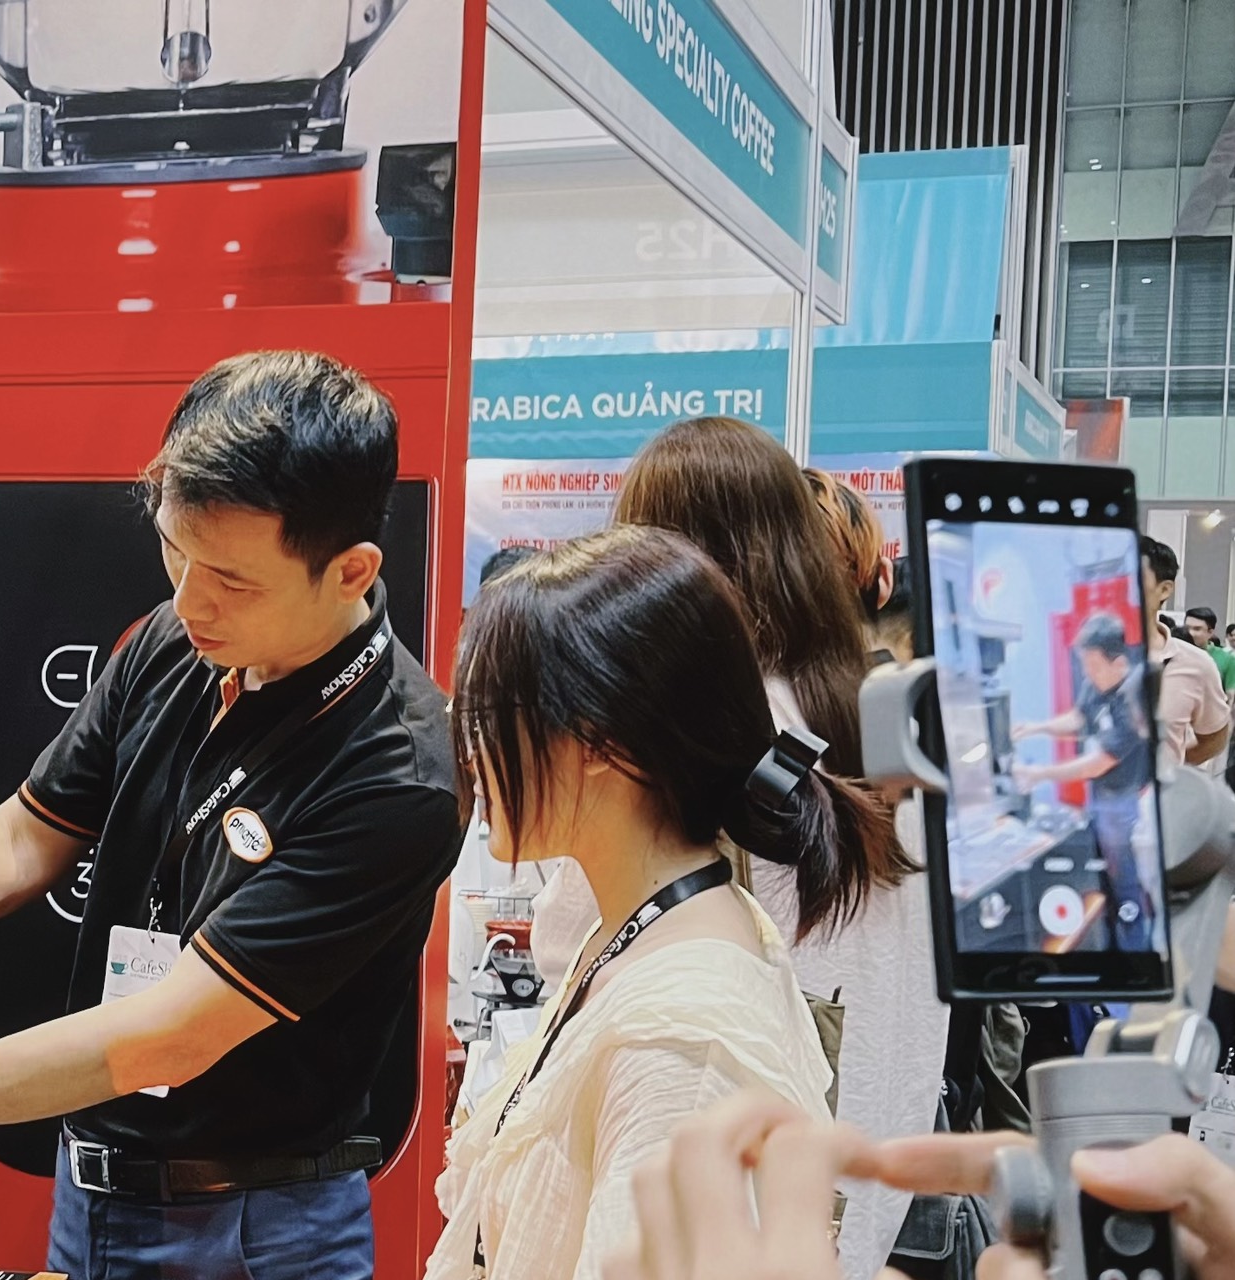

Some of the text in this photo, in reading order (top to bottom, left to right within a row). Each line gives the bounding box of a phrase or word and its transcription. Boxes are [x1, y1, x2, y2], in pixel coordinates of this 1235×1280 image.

[656, 0, 731, 126] SPECIALTY
[730, 82, 776, 177] COFFEE
[469, 381, 763, 423] RABICA QUẢNG TRỊ
[502, 473, 523, 492] HTX
[321, 645, 378, 700] CafeShow
[185, 782, 231, 835] CafeShow
